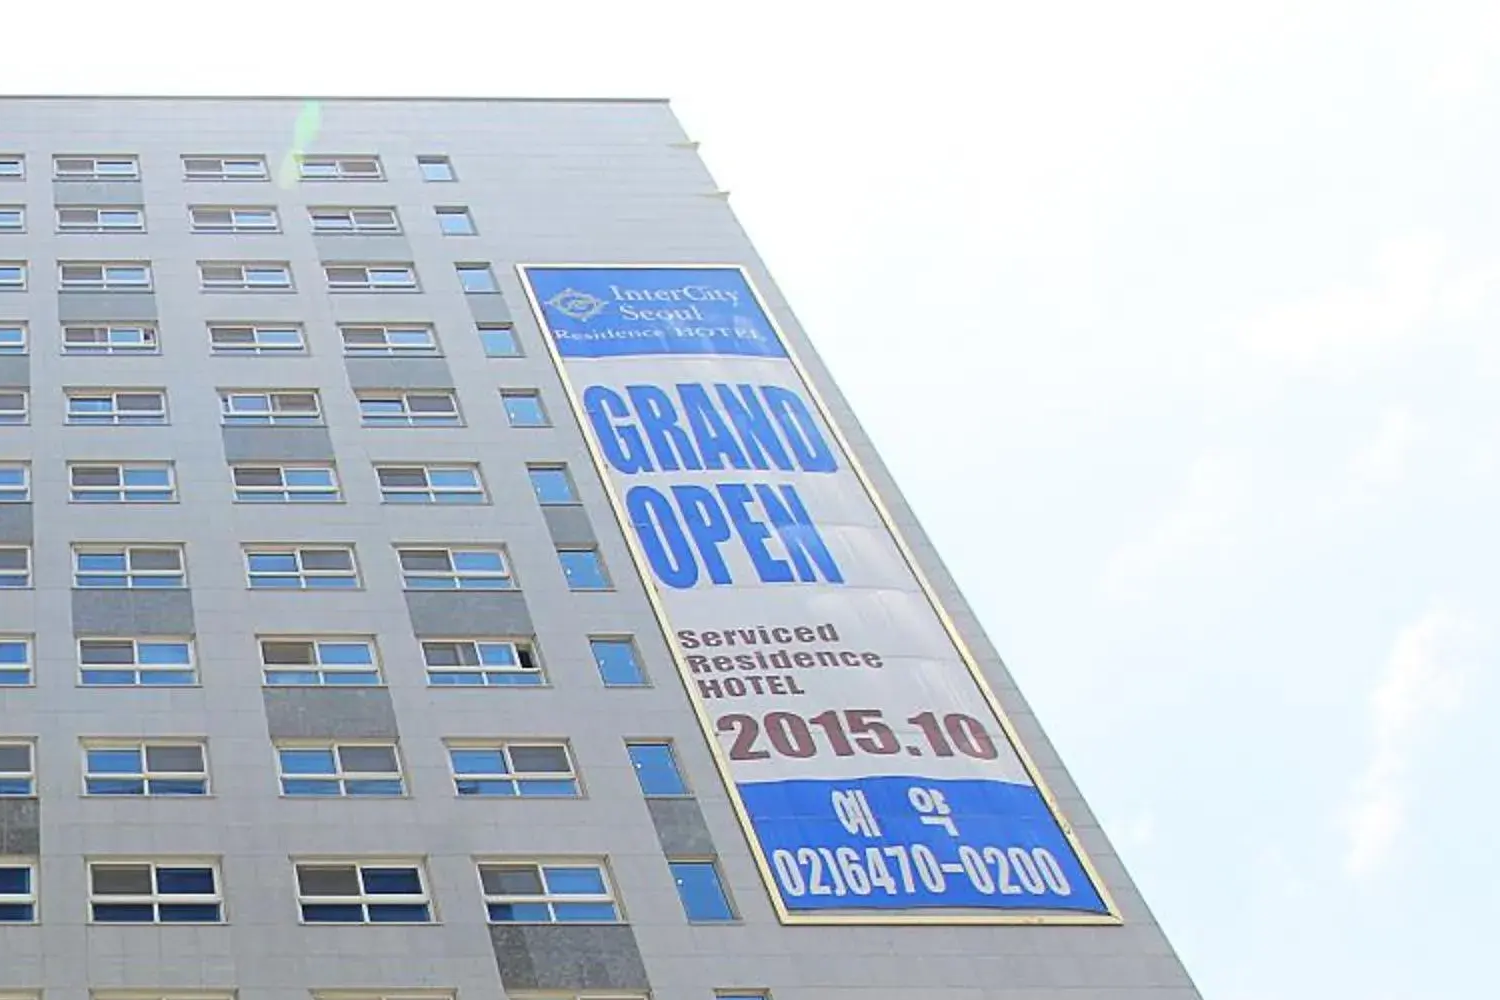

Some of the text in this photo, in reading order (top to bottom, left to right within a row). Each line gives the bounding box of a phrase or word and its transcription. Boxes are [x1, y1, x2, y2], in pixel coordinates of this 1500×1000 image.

[608, 284, 740, 307] InterCity
[619, 302, 704, 322] Seoul
[553, 326, 767, 342] Residence HOTEL
[582, 382, 840, 477] GRAND
[623, 483, 845, 590] OPEN
[677, 622, 840, 650] Serviced
[686, 647, 883, 675] Residence
[697, 674, 805, 699] HOTEL
[716, 708, 999, 761] 2015.10
[771, 843, 1072, 898] 02)6470-0200
